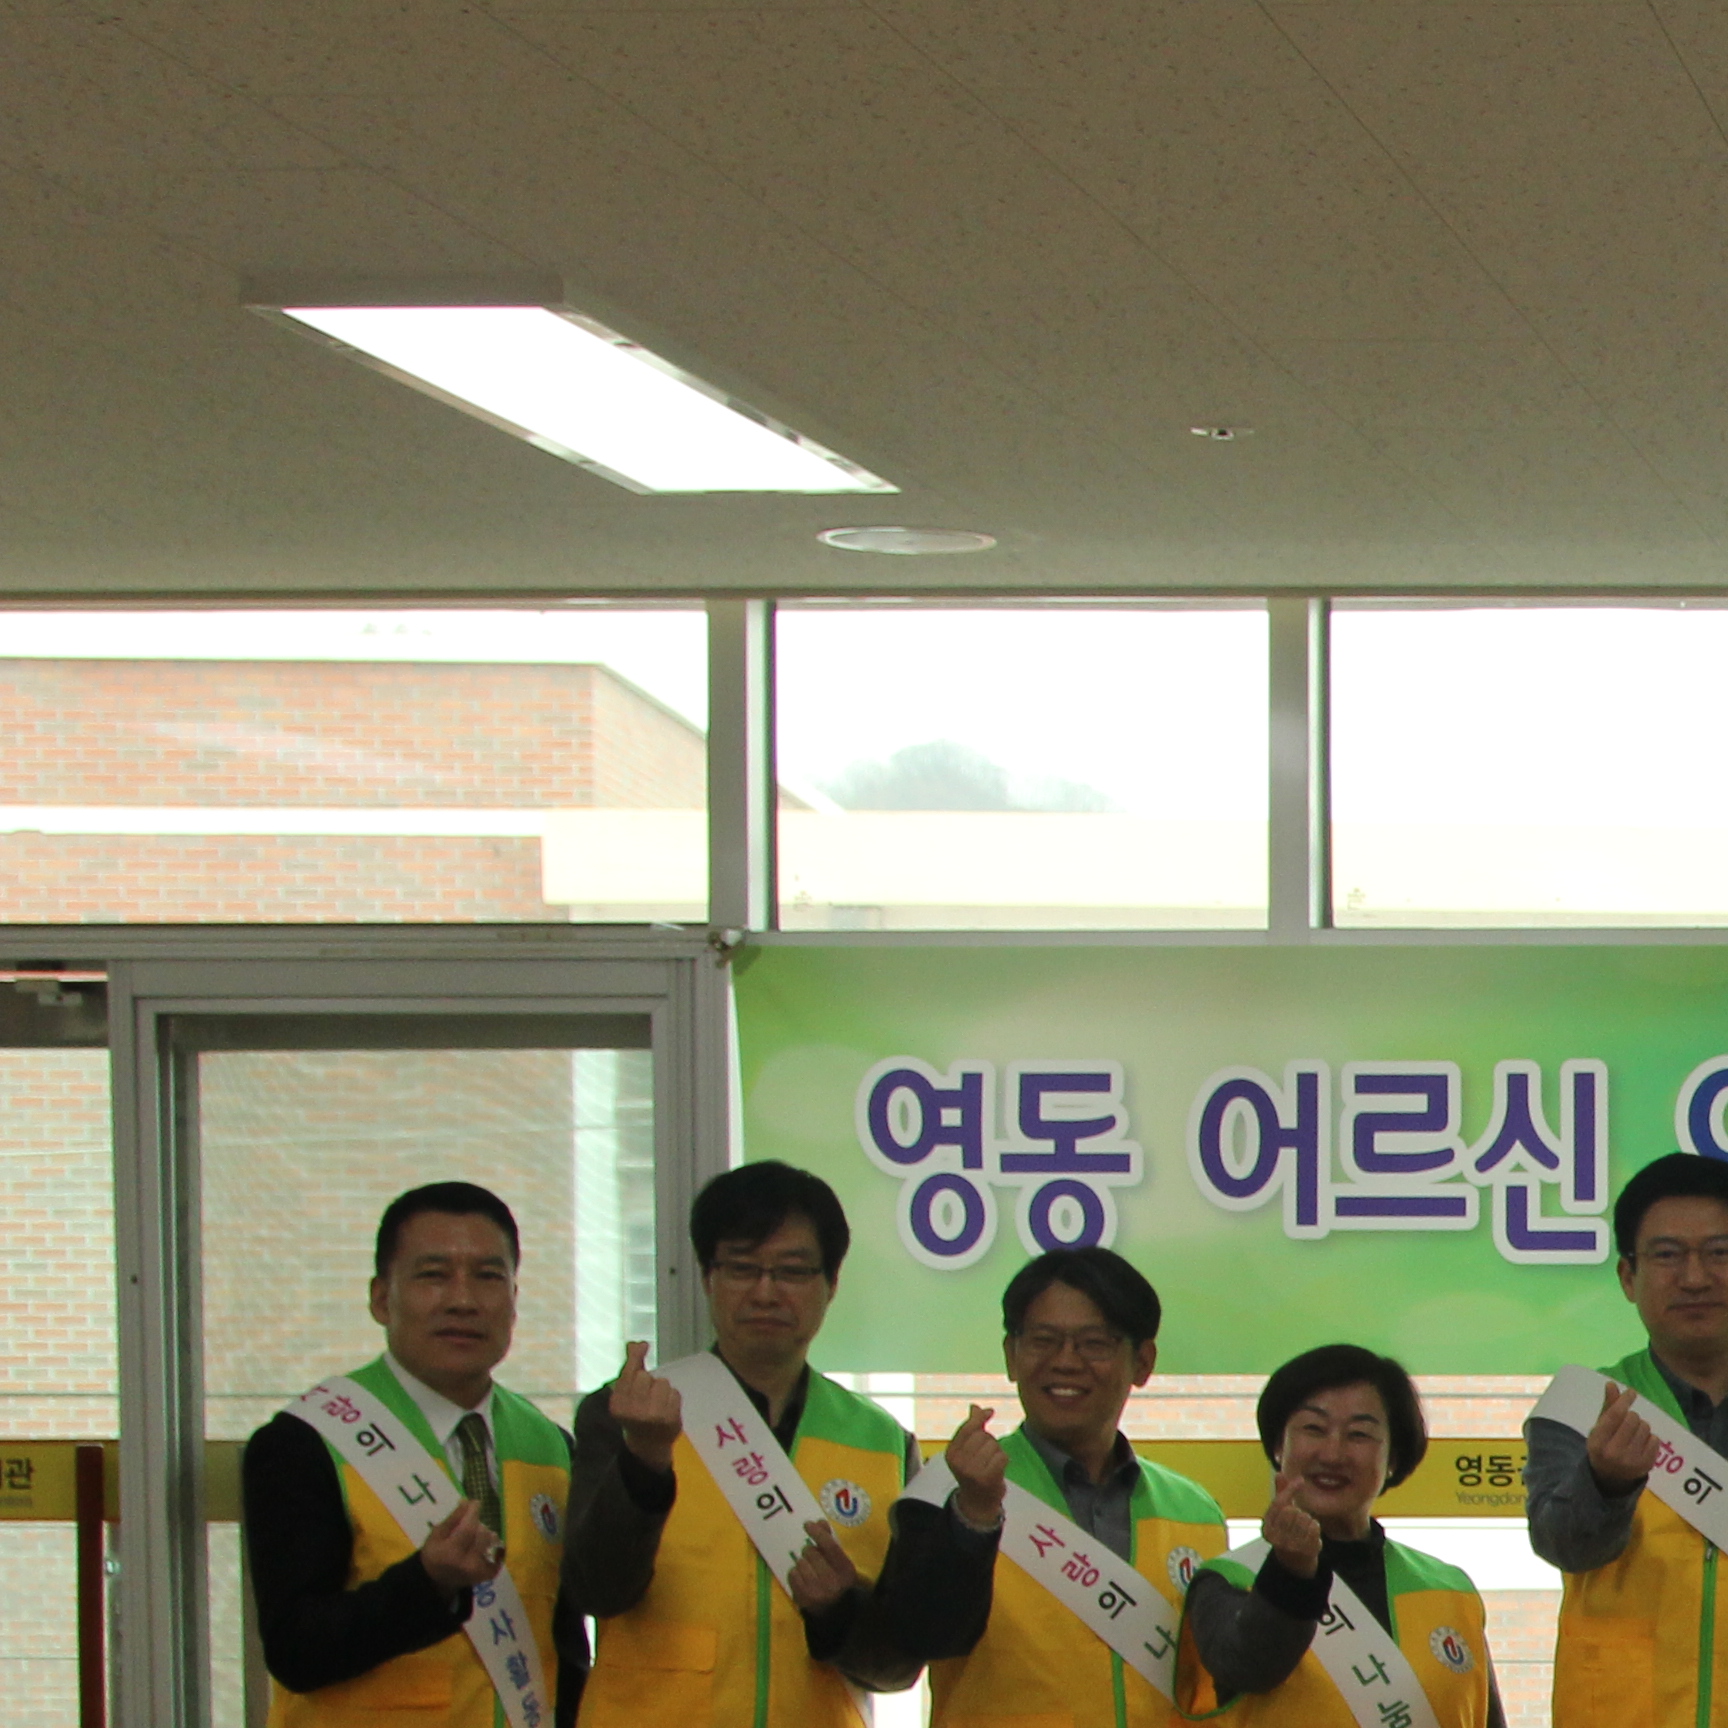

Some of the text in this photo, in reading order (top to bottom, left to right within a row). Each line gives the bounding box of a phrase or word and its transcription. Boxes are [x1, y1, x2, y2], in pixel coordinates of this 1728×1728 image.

[866, 1066, 1133, 1257] 영동
[1198, 1070, 1599, 1252] 어르신
[714, 1416, 794, 1521] 사랑의
[1028, 1523, 1138, 1620] 사랑의
